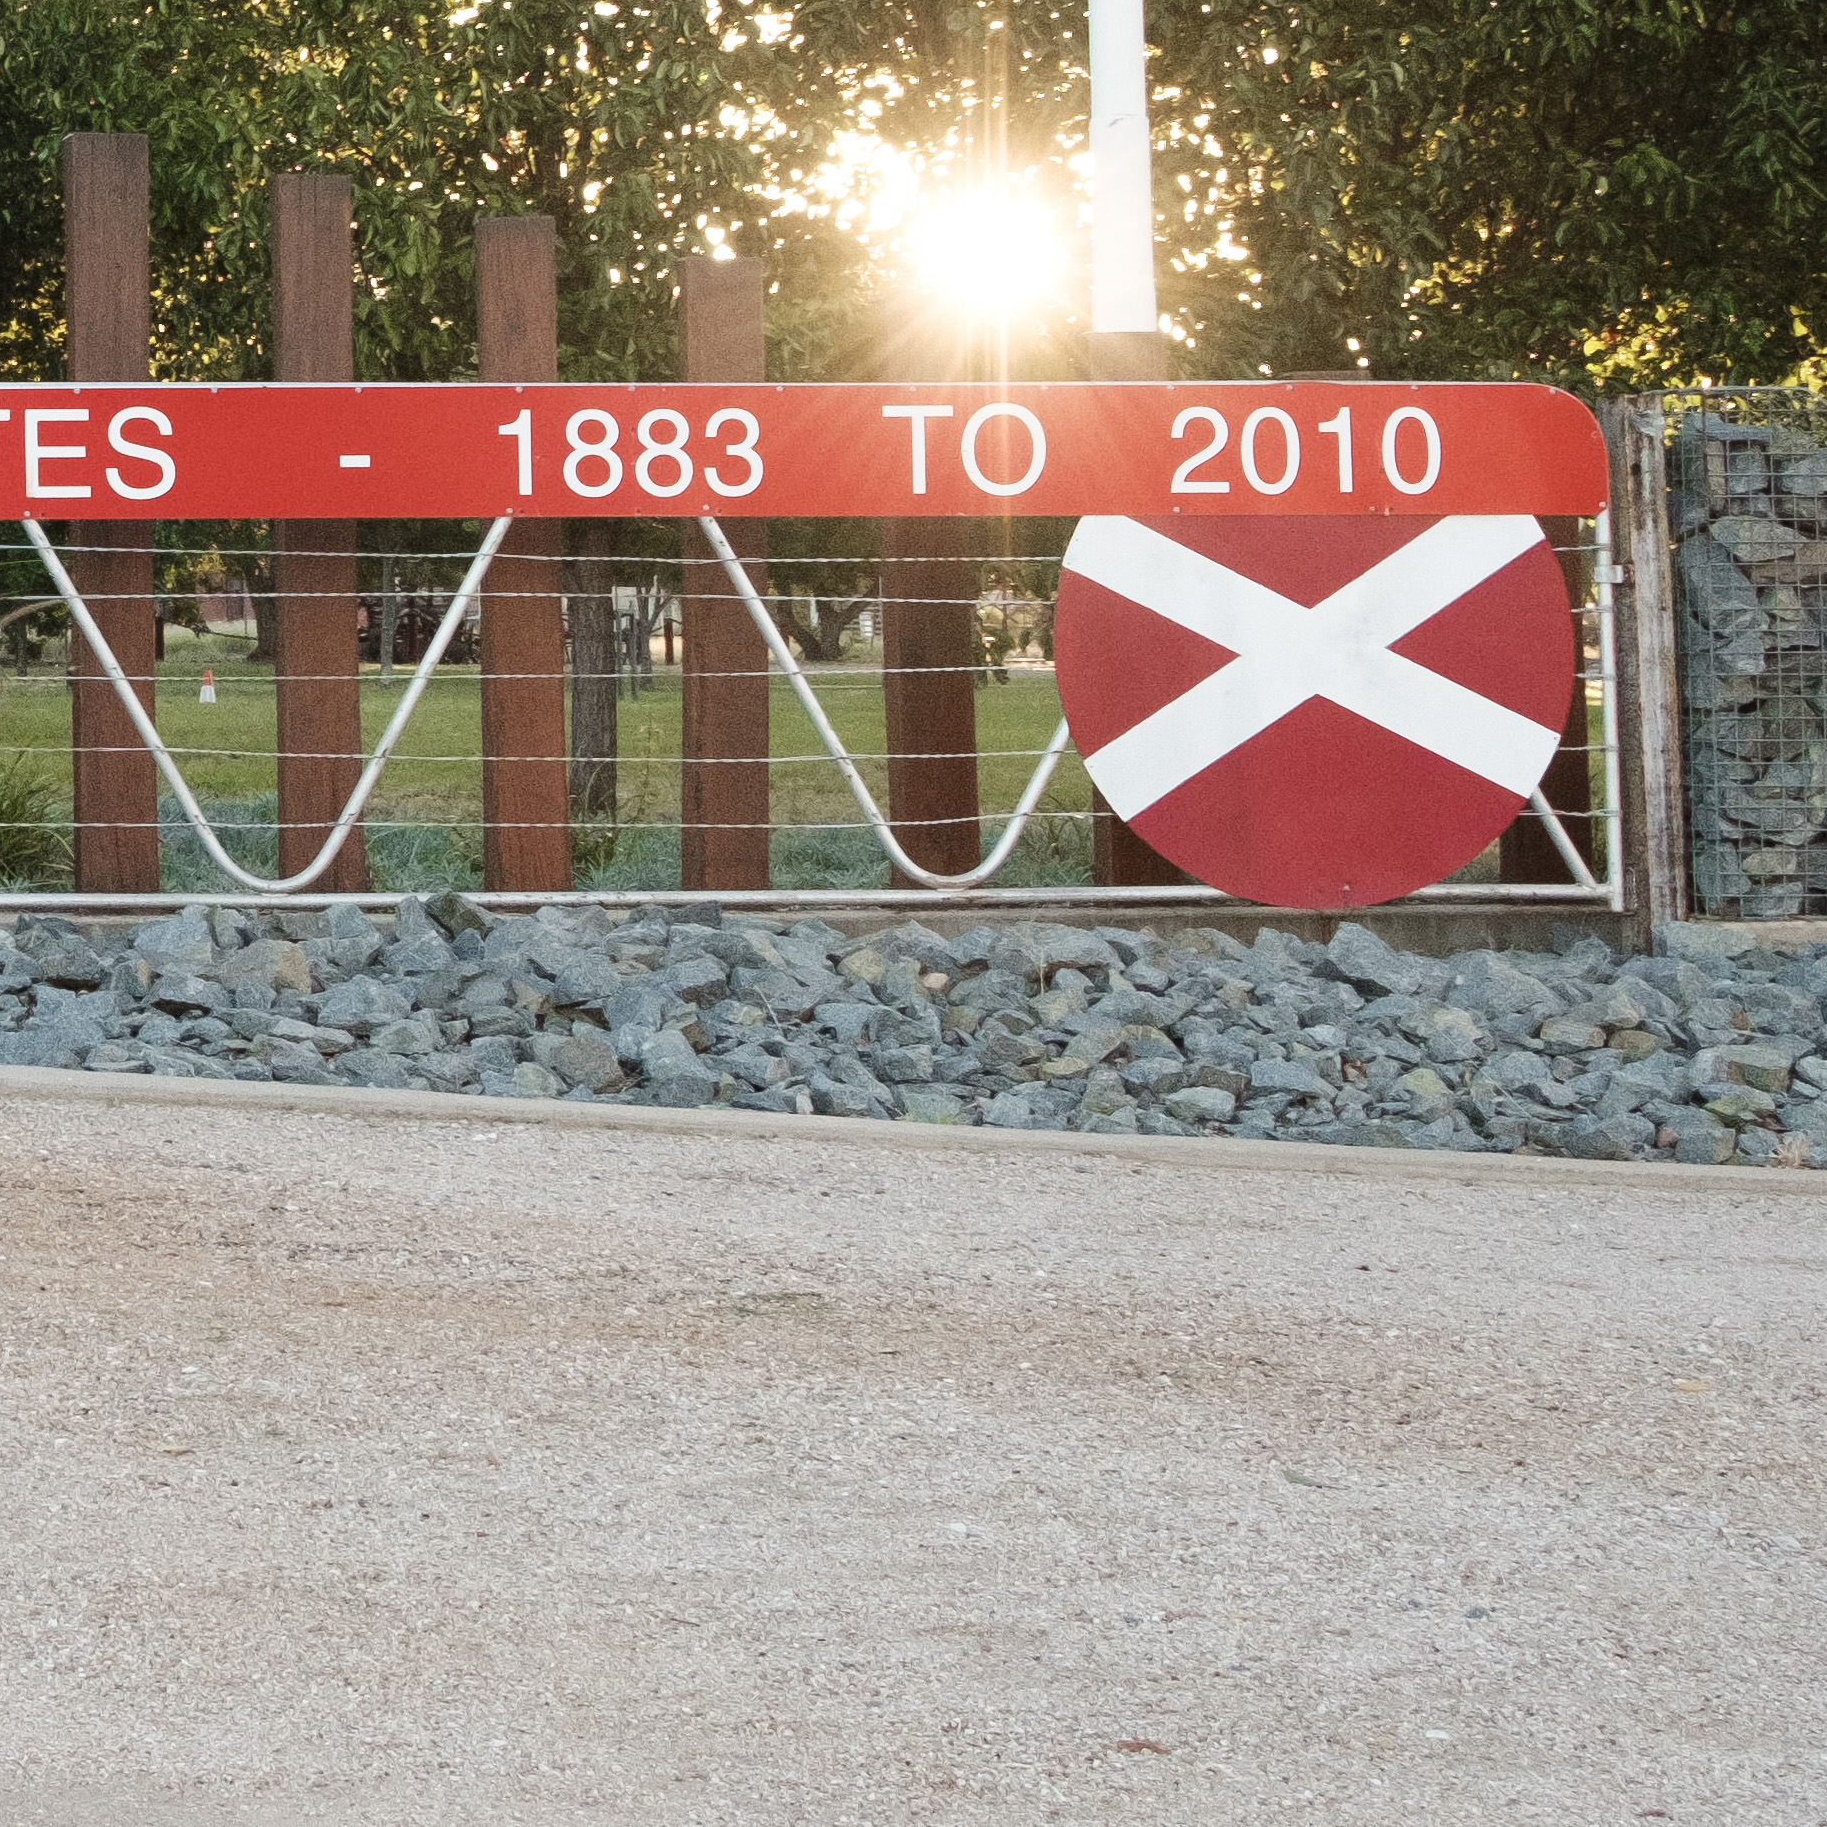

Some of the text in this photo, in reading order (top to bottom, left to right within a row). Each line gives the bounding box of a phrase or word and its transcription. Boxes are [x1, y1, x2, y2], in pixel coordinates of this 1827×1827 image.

[339, 454, 371, 468] -
[498, 407, 764, 498] 1883
[882, 402, 1047, 497] TO
[1169, 404, 1442, 496] 2010
